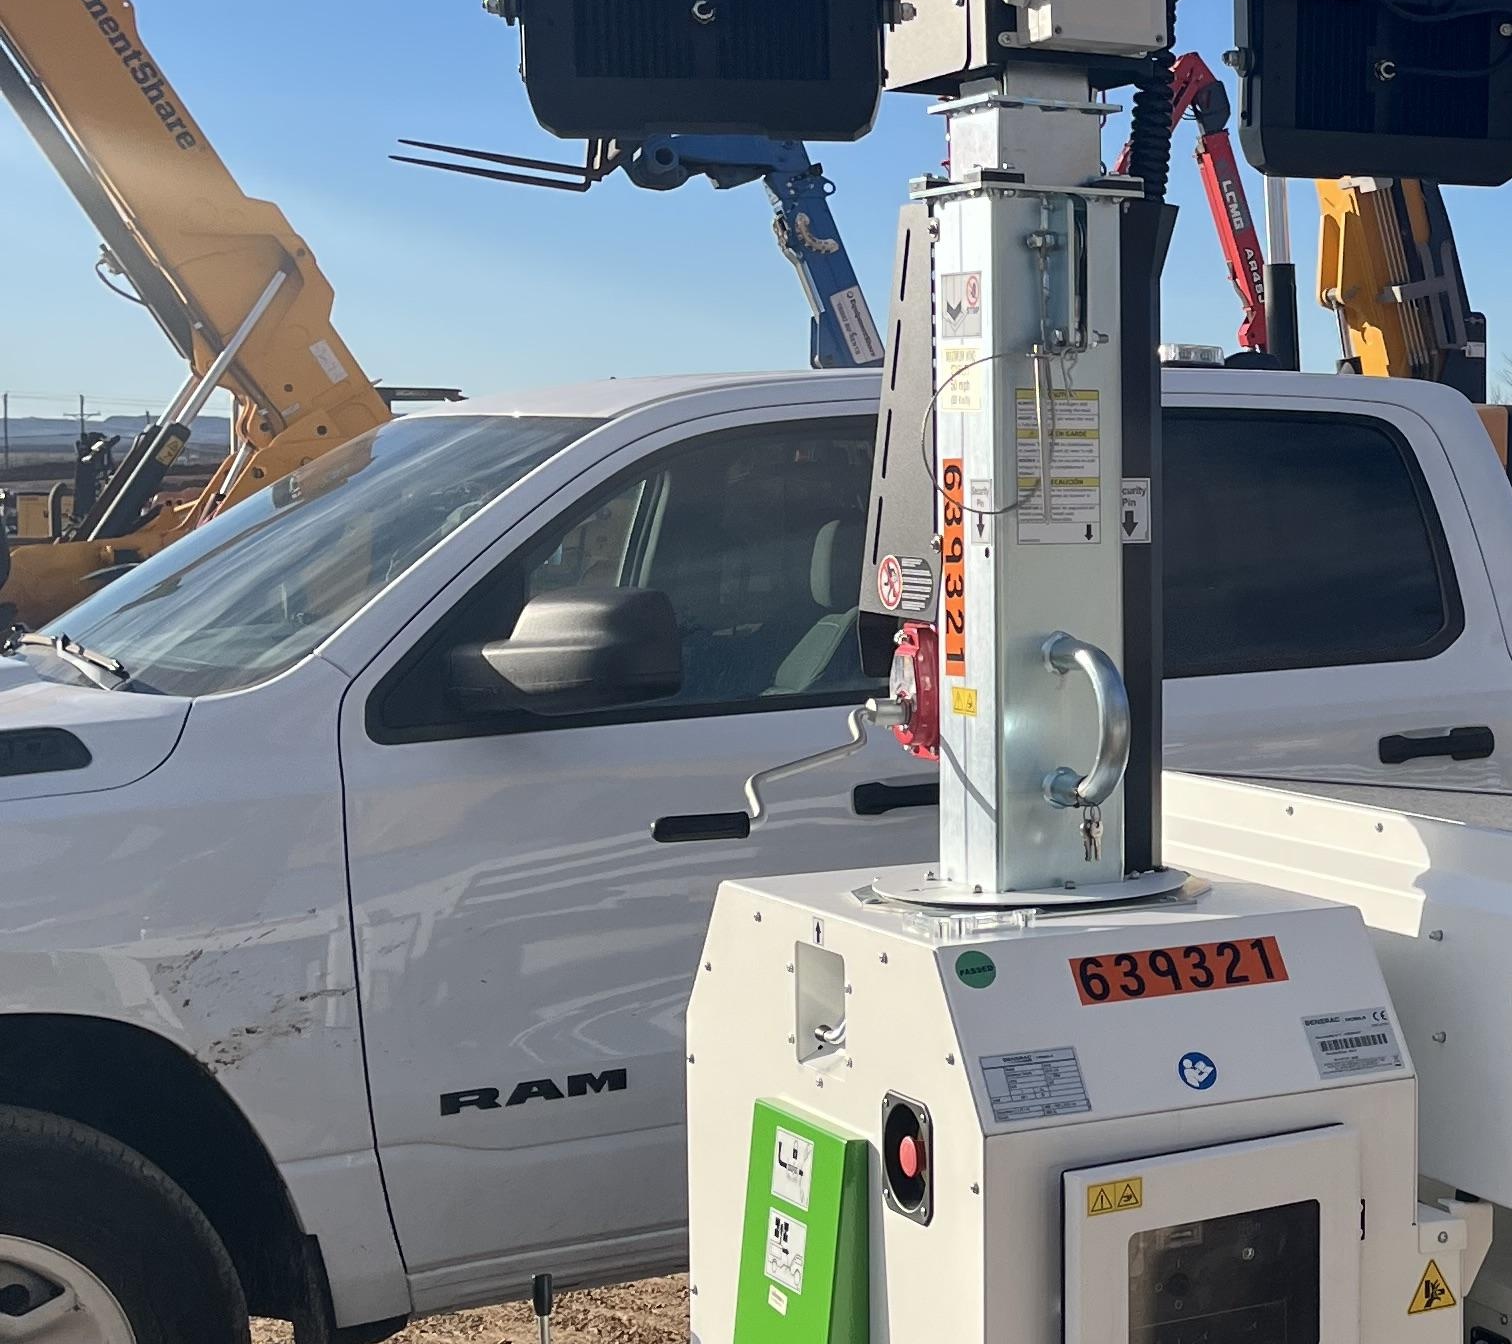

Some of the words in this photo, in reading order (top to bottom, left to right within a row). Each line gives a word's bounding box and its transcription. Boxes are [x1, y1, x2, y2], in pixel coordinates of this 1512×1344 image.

[1121, 485, 1148, 498] curity
[943, 464, 965, 662] 639321
[959, 963, 995, 977] PASSED
[1078, 937, 1277, 1003] 639321
[439, 1067, 628, 1117] RAM
